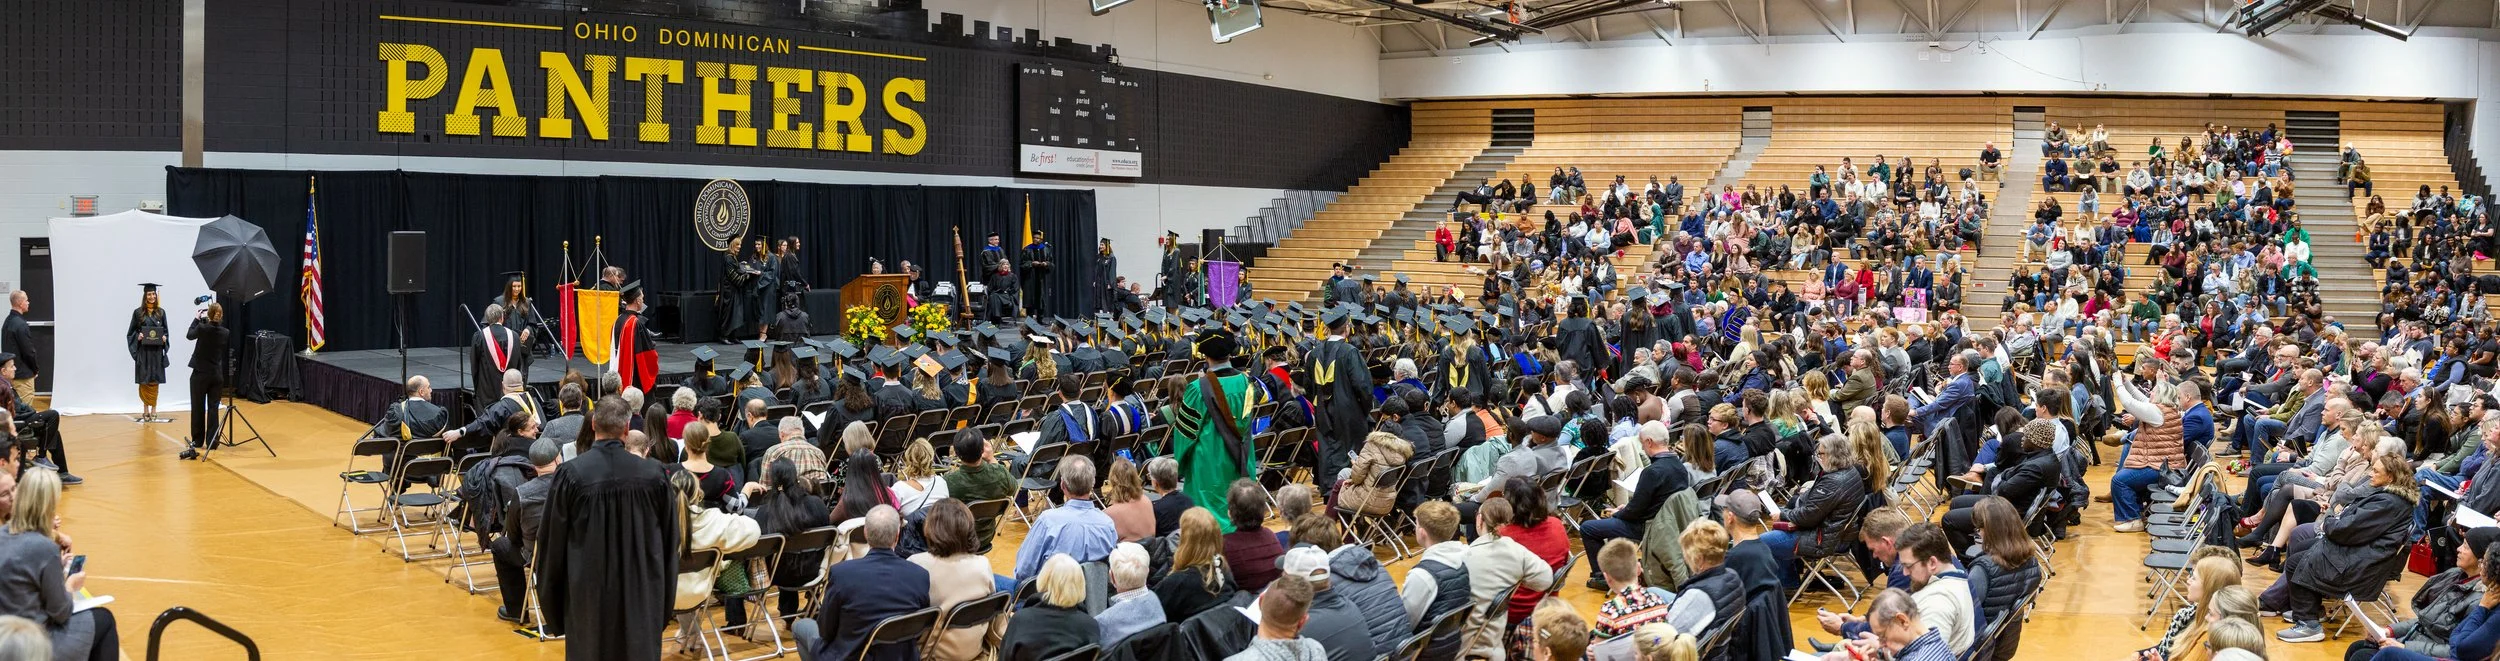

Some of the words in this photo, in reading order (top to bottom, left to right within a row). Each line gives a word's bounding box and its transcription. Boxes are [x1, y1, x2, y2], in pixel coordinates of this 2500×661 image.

[574, 22, 637, 43] OHIO
[659, 28, 790, 54] DOMINICAN
[378, 42, 927, 156] PANTHERS
[1076, 109, 1090, 118] player
[1030, 153, 1039, 163] Be
[1038, 151, 1057, 166] first!
[696, 201, 704, 223] OHIO
[702, 182, 734, 201] DOMINICAN
[733, 187, 748, 226] UNIVERSITY
[715, 240, 728, 248] 1911
